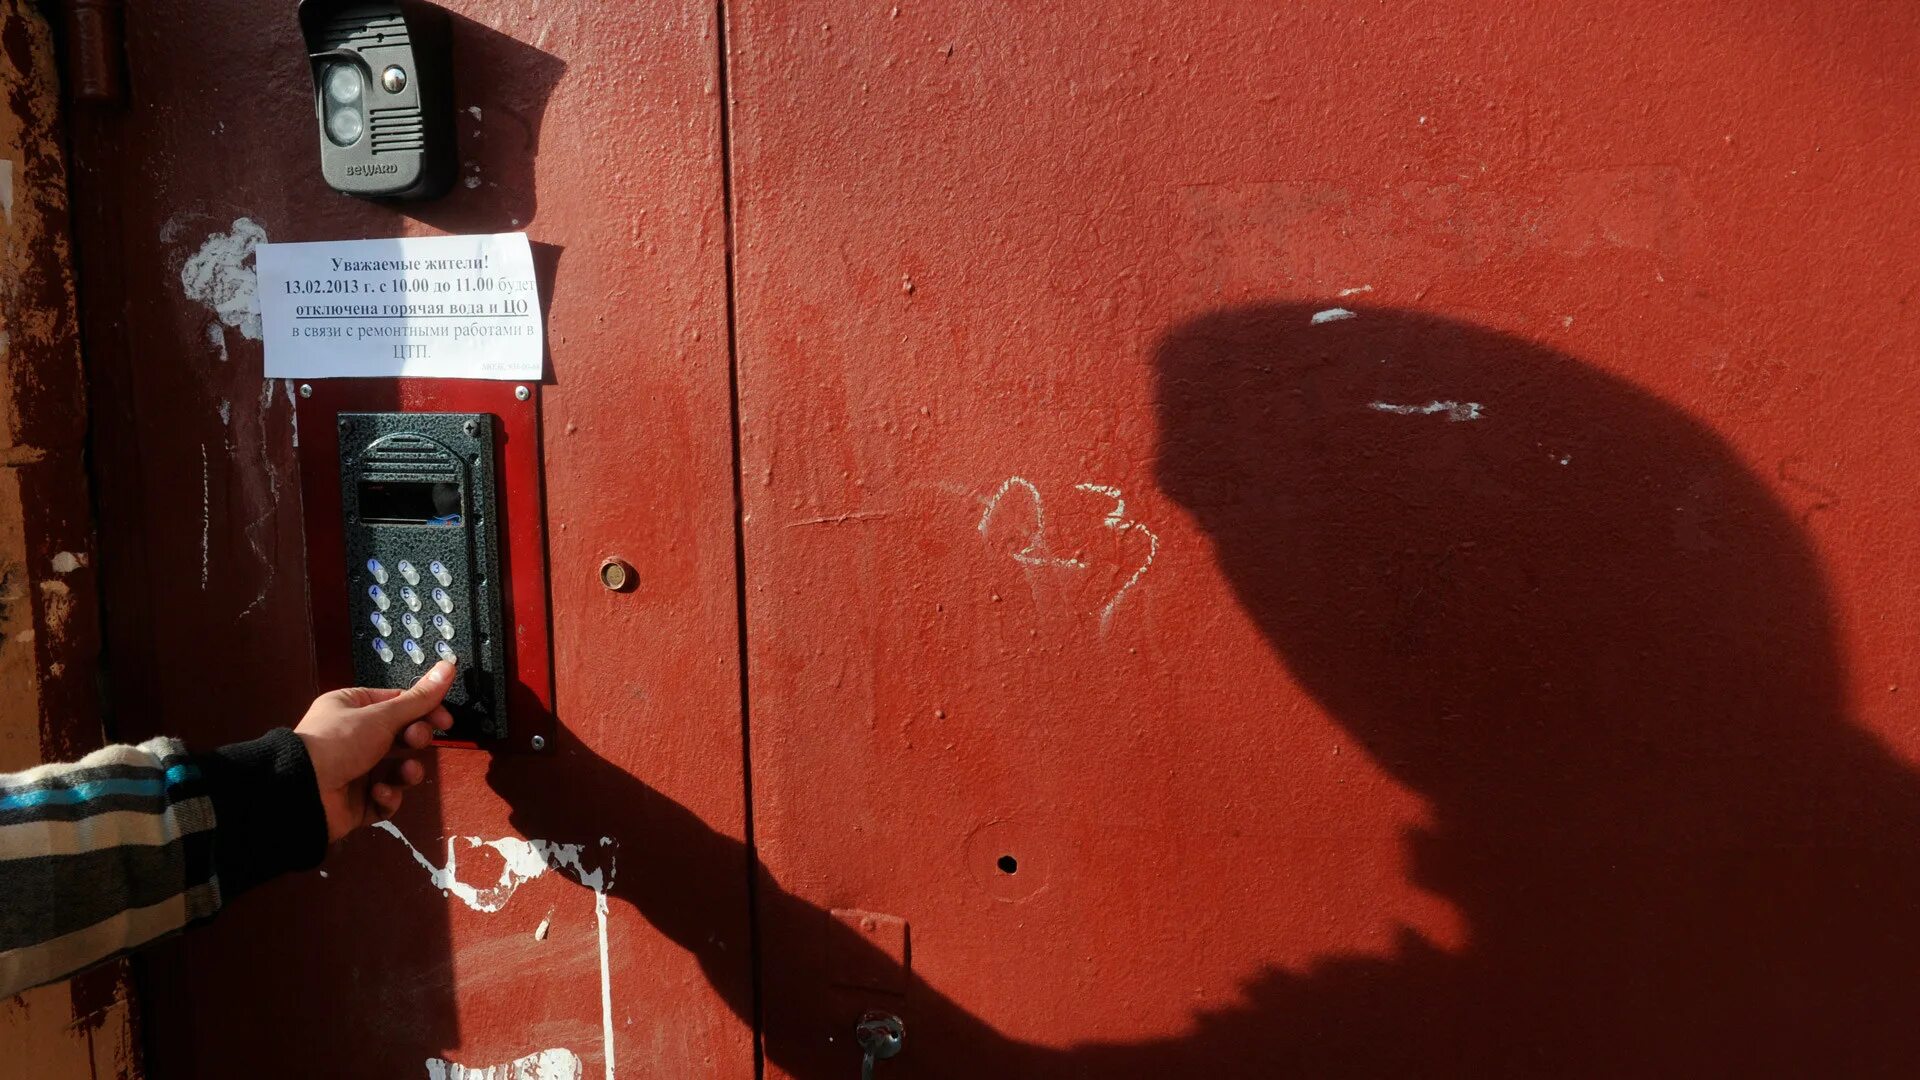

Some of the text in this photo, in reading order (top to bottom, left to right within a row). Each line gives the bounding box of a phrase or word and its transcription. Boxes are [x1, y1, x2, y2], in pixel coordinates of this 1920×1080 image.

[331, 255, 489, 272] Уважаемые жители!
[285, 277, 534, 294] 13.02.2013 г. с 10.00 до 11.00 будет
[296, 299, 528, 318] отключена горячая вода и ЦО
[292, 322, 534, 340] в связи с ремонтными работами в
[393, 344, 432, 360] ЦТП.
[976, 475, 1159, 628] 23
[401, 561, 408, 572] 2
[433, 563, 440, 574] 3
[371, 587, 442, 600] 4 5 6
[373, 613, 443, 626] 7 8 9
